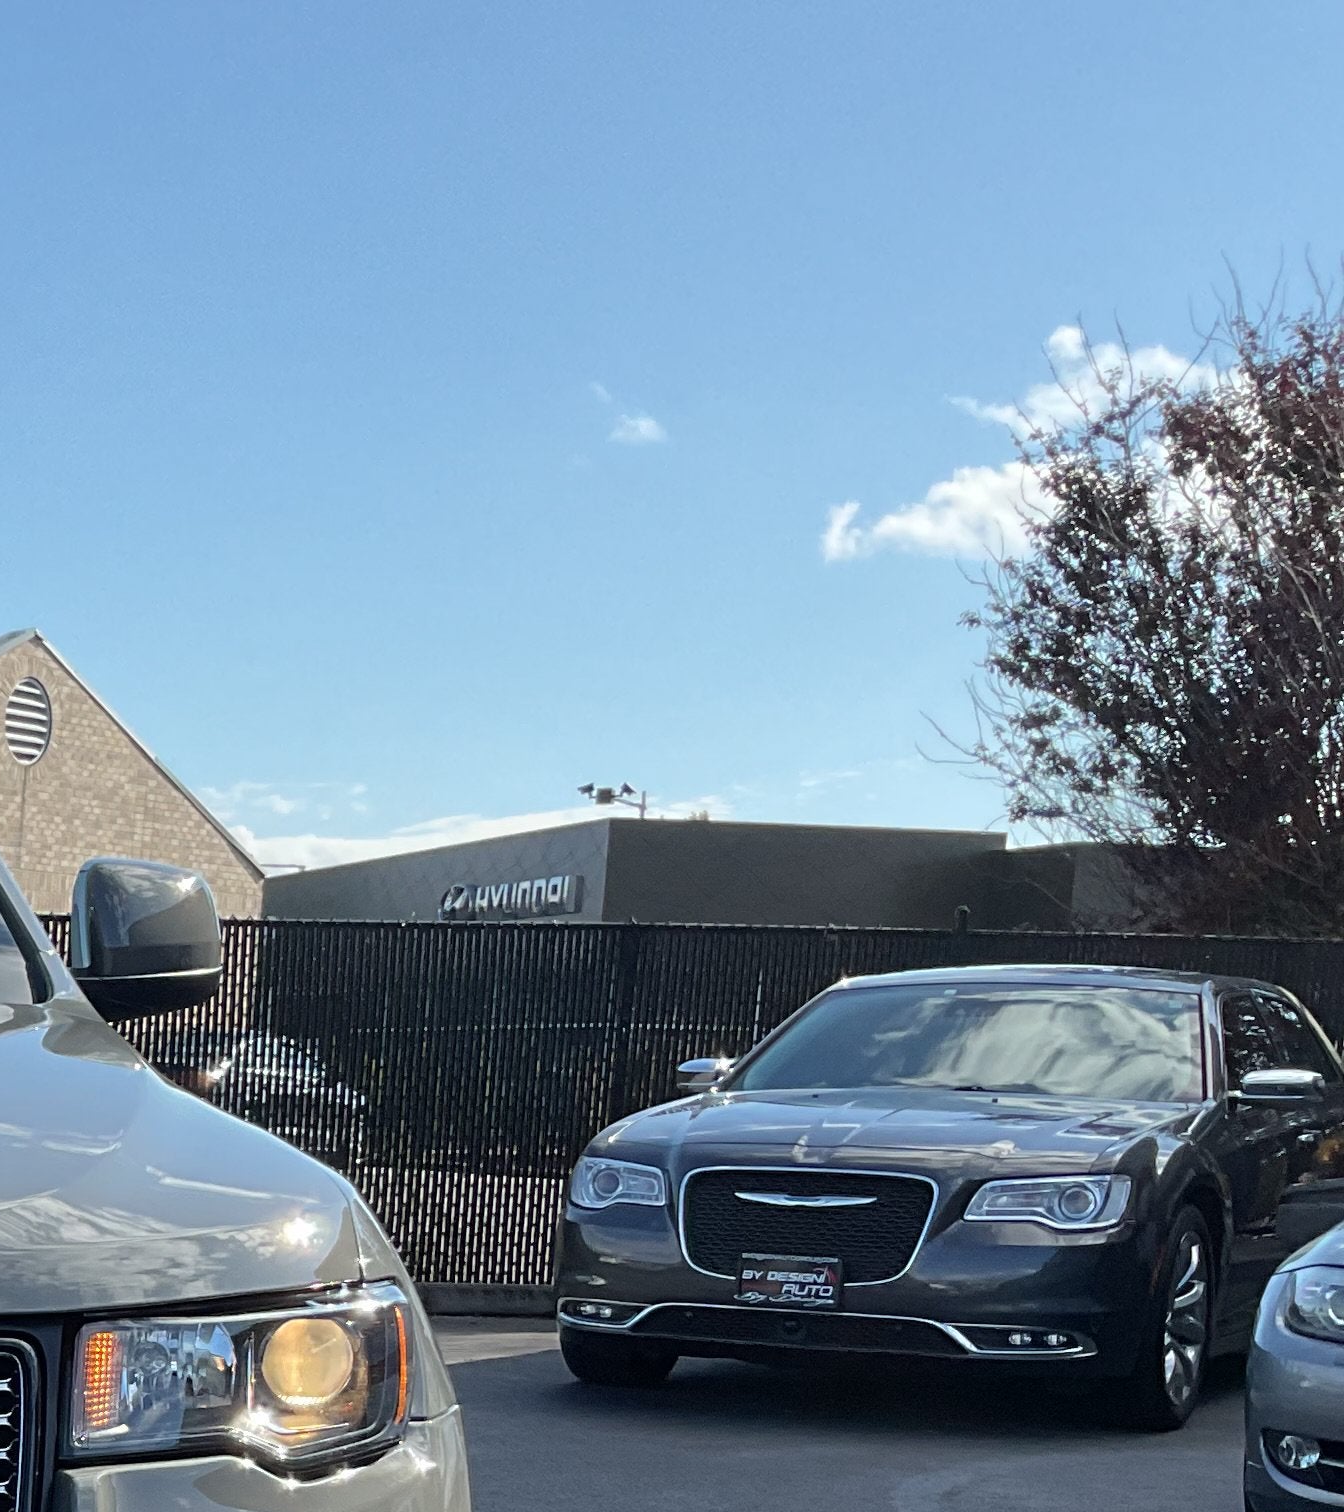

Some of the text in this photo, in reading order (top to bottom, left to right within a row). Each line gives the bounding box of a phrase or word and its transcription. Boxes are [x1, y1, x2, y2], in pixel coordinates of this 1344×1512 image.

[475, 875, 570, 912] HYUNDAI
[742, 1269, 826, 1283] BY DESIGN
[781, 1283, 833, 1296] AUTO
